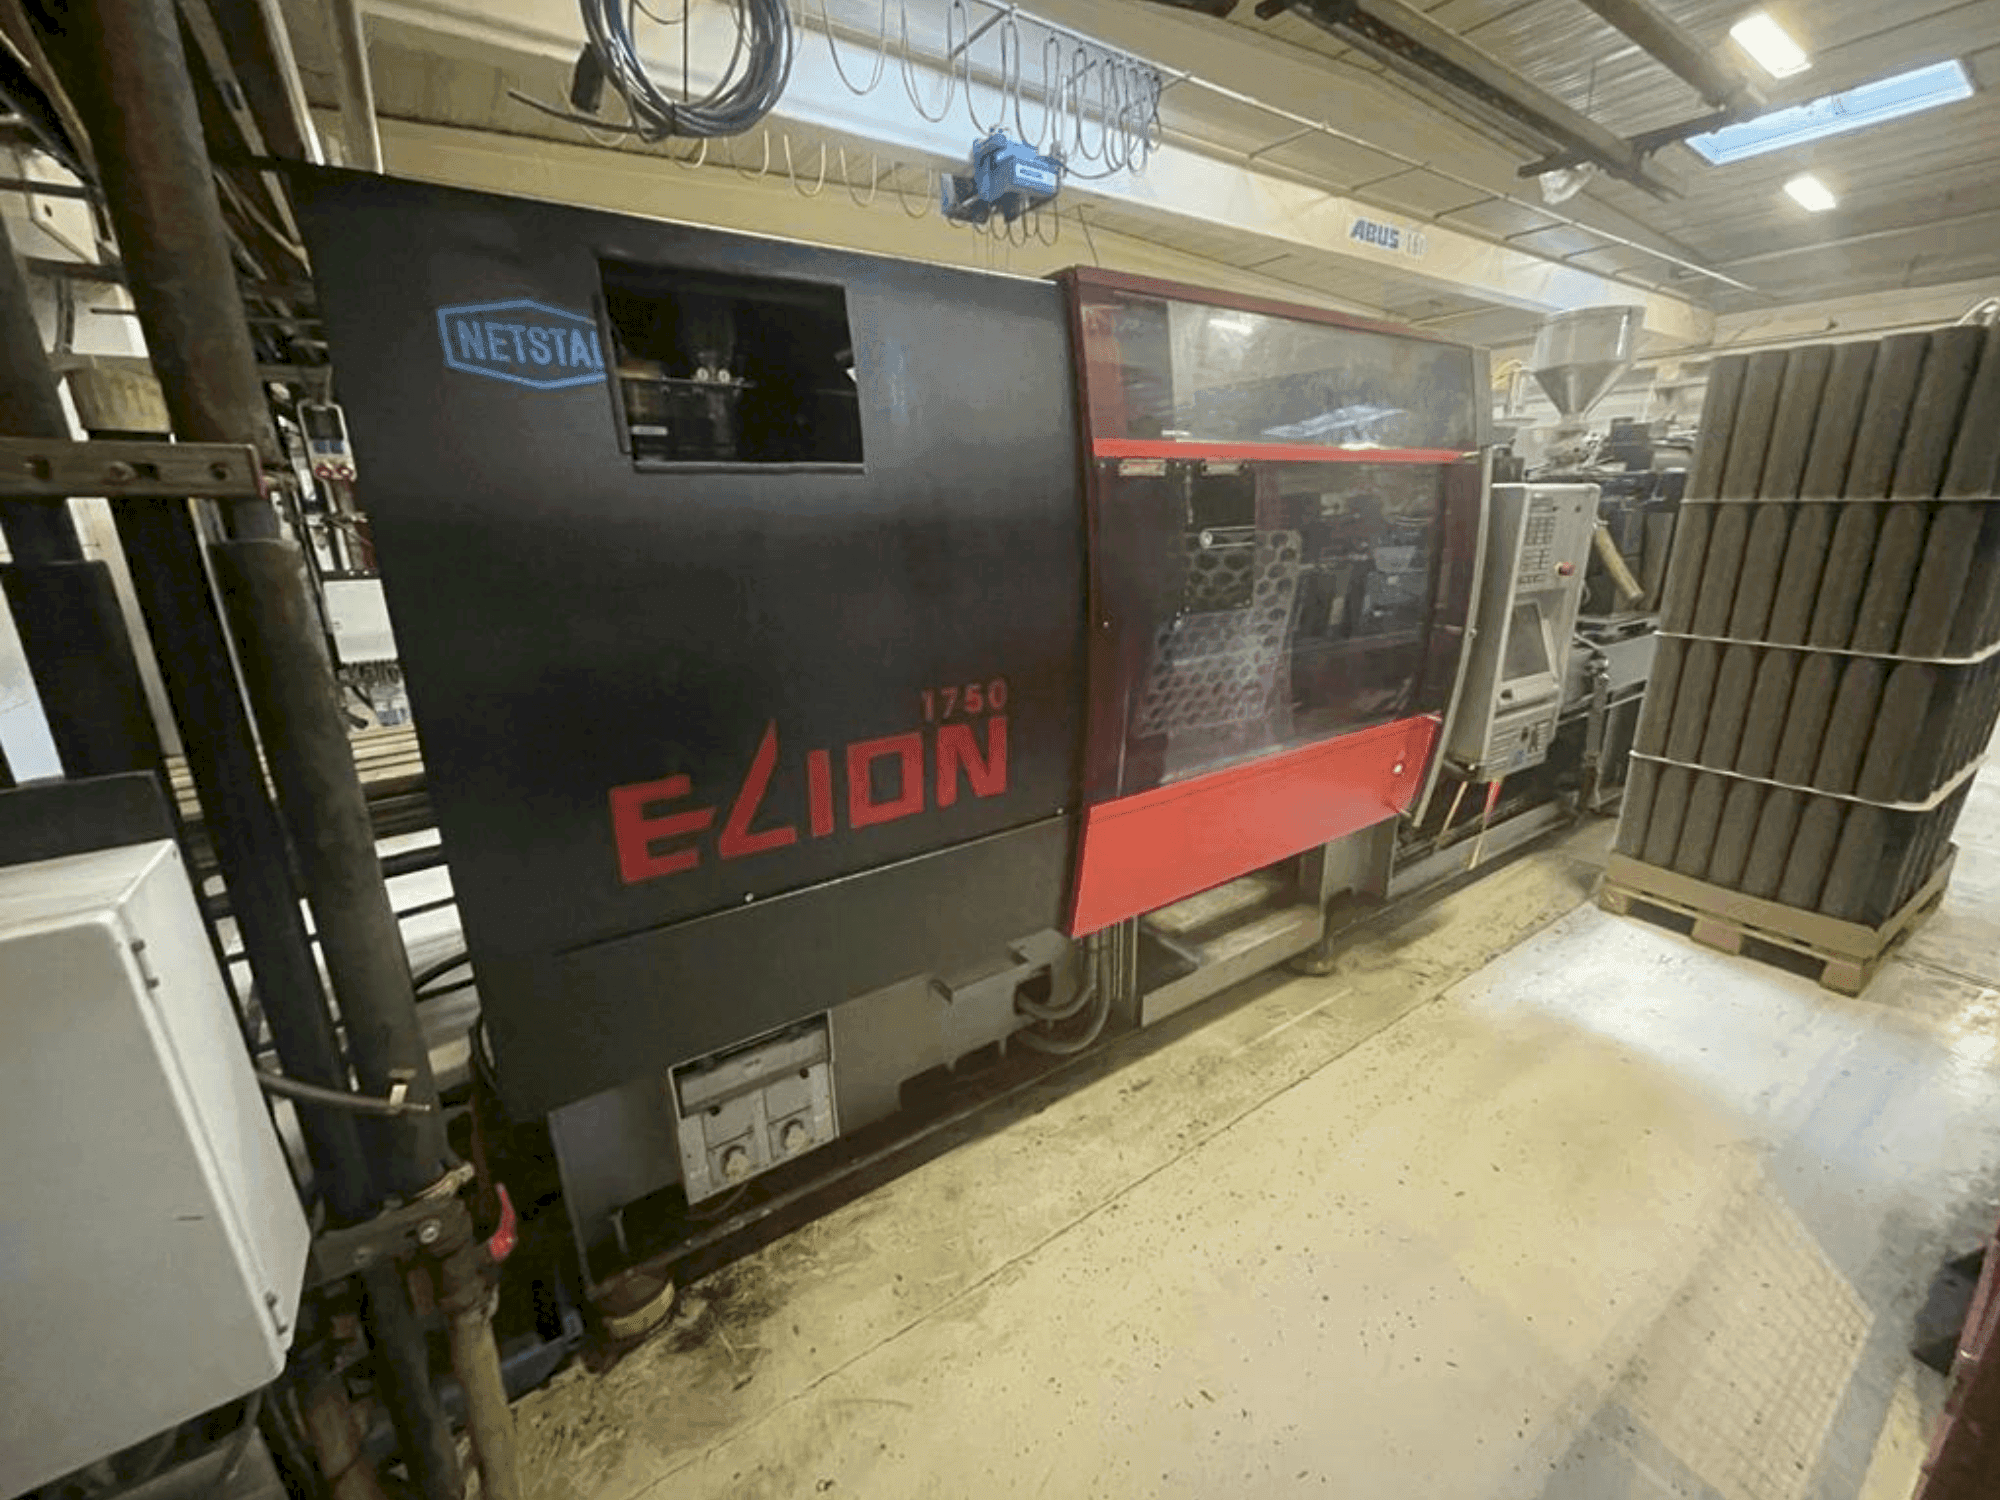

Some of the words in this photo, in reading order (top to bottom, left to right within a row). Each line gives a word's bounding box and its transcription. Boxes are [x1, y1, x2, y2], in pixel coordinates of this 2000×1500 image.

[1351, 219, 1400, 249] ABUS
[921, 678, 1008, 720] 1750
[610, 717, 1008, 885] ELION
